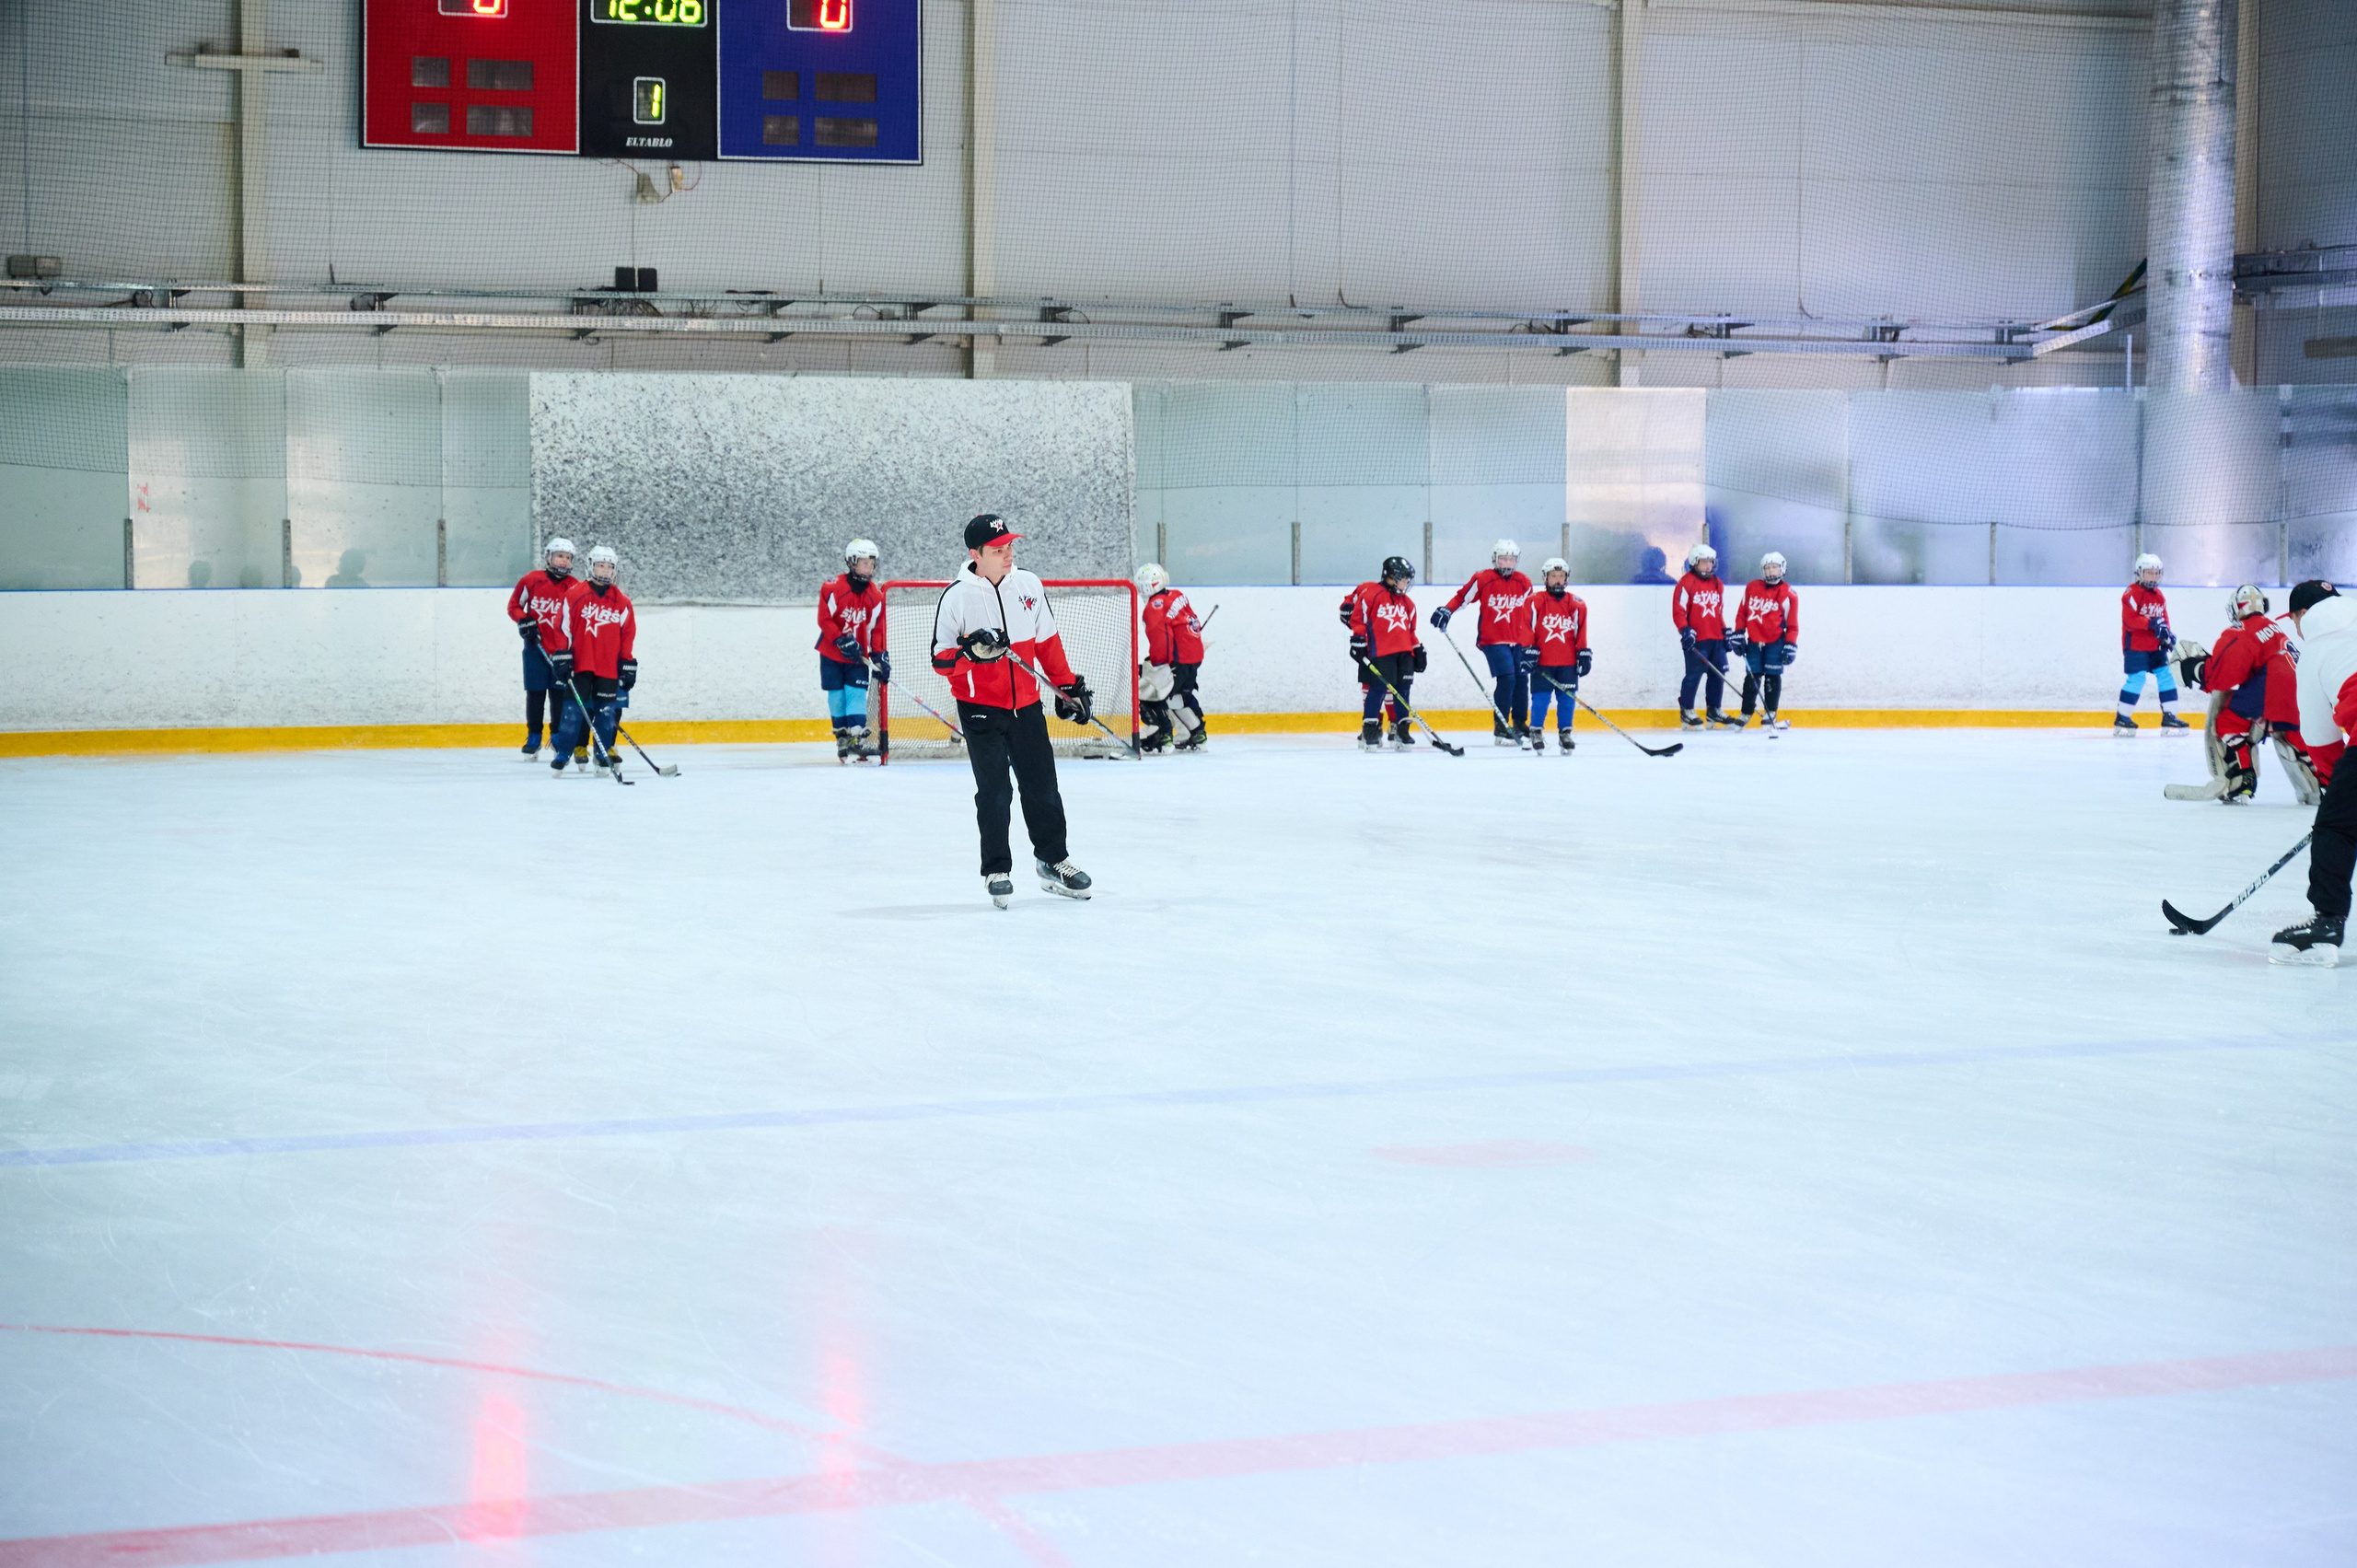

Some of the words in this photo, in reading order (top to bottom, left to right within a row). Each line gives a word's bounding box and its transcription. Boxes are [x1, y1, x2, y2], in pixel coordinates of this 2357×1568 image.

[652, 84, 662, 118] 1
[626, 136, 673, 147] ELTABLO
[1487, 593, 1526, 607] STARS
[580, 601, 621, 623] STARS
